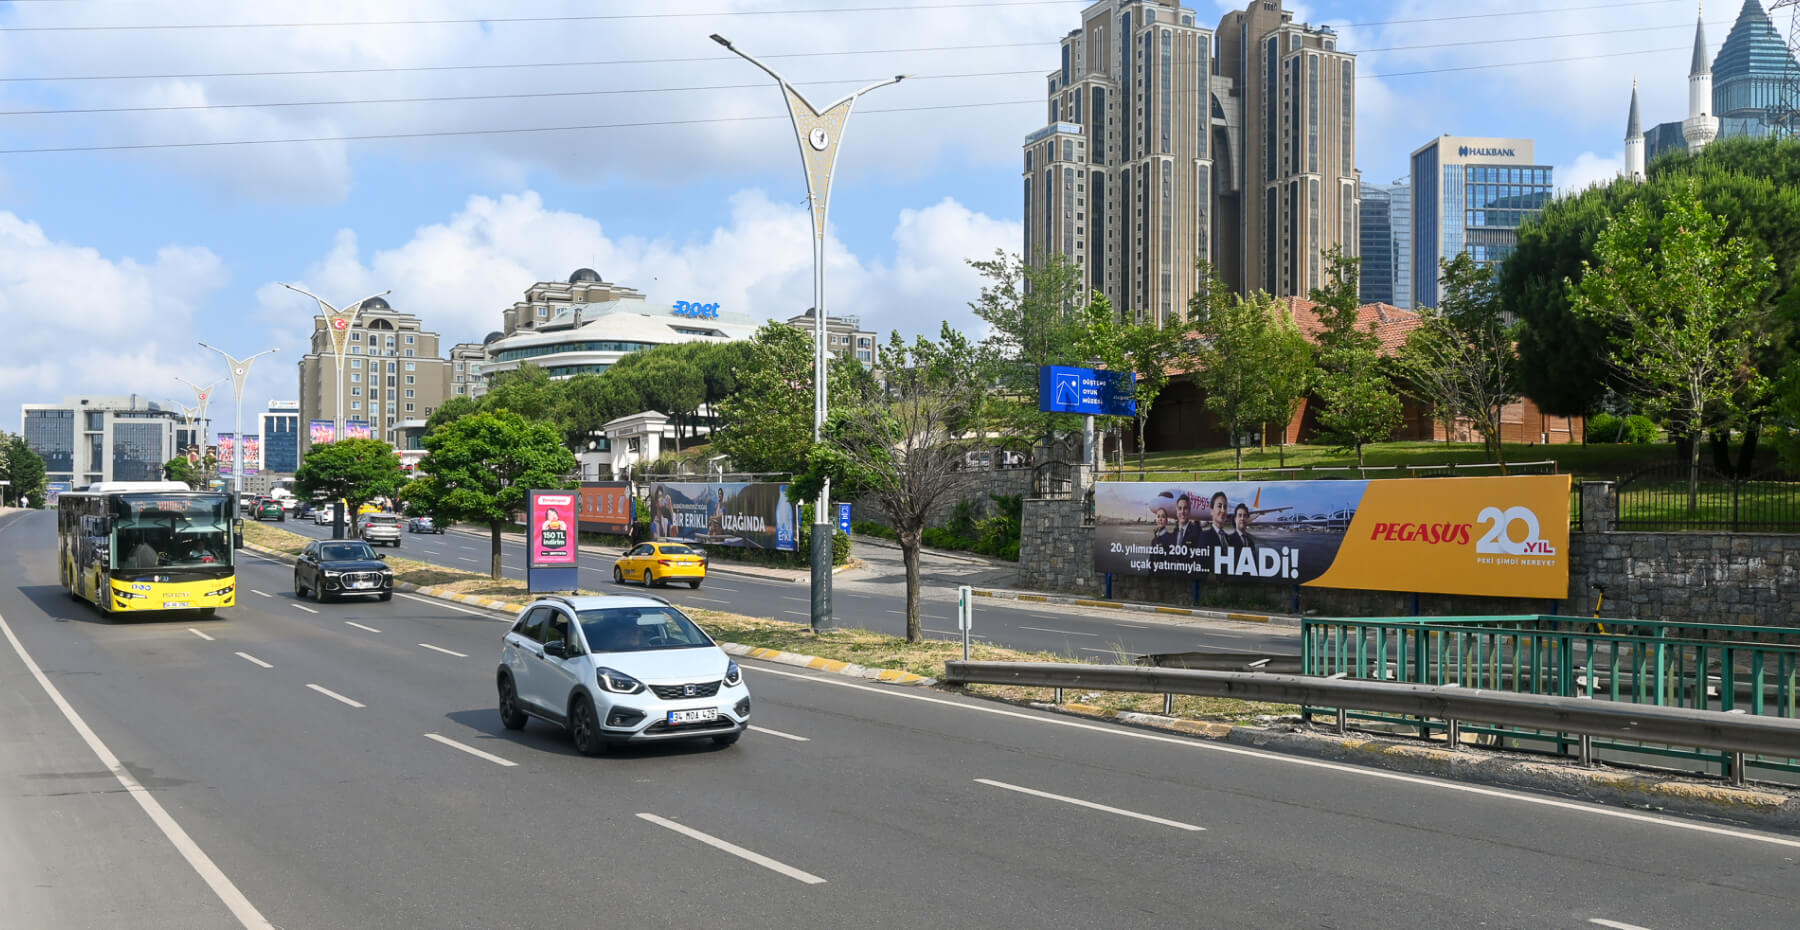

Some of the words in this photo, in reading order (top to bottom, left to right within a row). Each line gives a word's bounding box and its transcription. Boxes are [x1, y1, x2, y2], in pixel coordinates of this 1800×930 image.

[1469, 147, 1516, 157] HALKBANK
[1082, 388, 1098, 396] OYUN
[672, 511, 684, 528] BİR
[685, 511, 708, 529] ERİKLİ
[721, 511, 766, 533] UZAĞINDA
[542, 531, 555, 539] 150
[1370, 523, 1472, 545] PEGASUS
[1110, 542, 1124, 554] 20.
[1124, 542, 1168, 558] yılımızda,
[1168, 545, 1188, 556] 200
[1189, 546, 1210, 560] yeni
[1130, 560, 1151, 574] uçak
[1153, 560, 1210, 575] yatırımıyla...
[1213, 545, 1300, 580] HADi!
